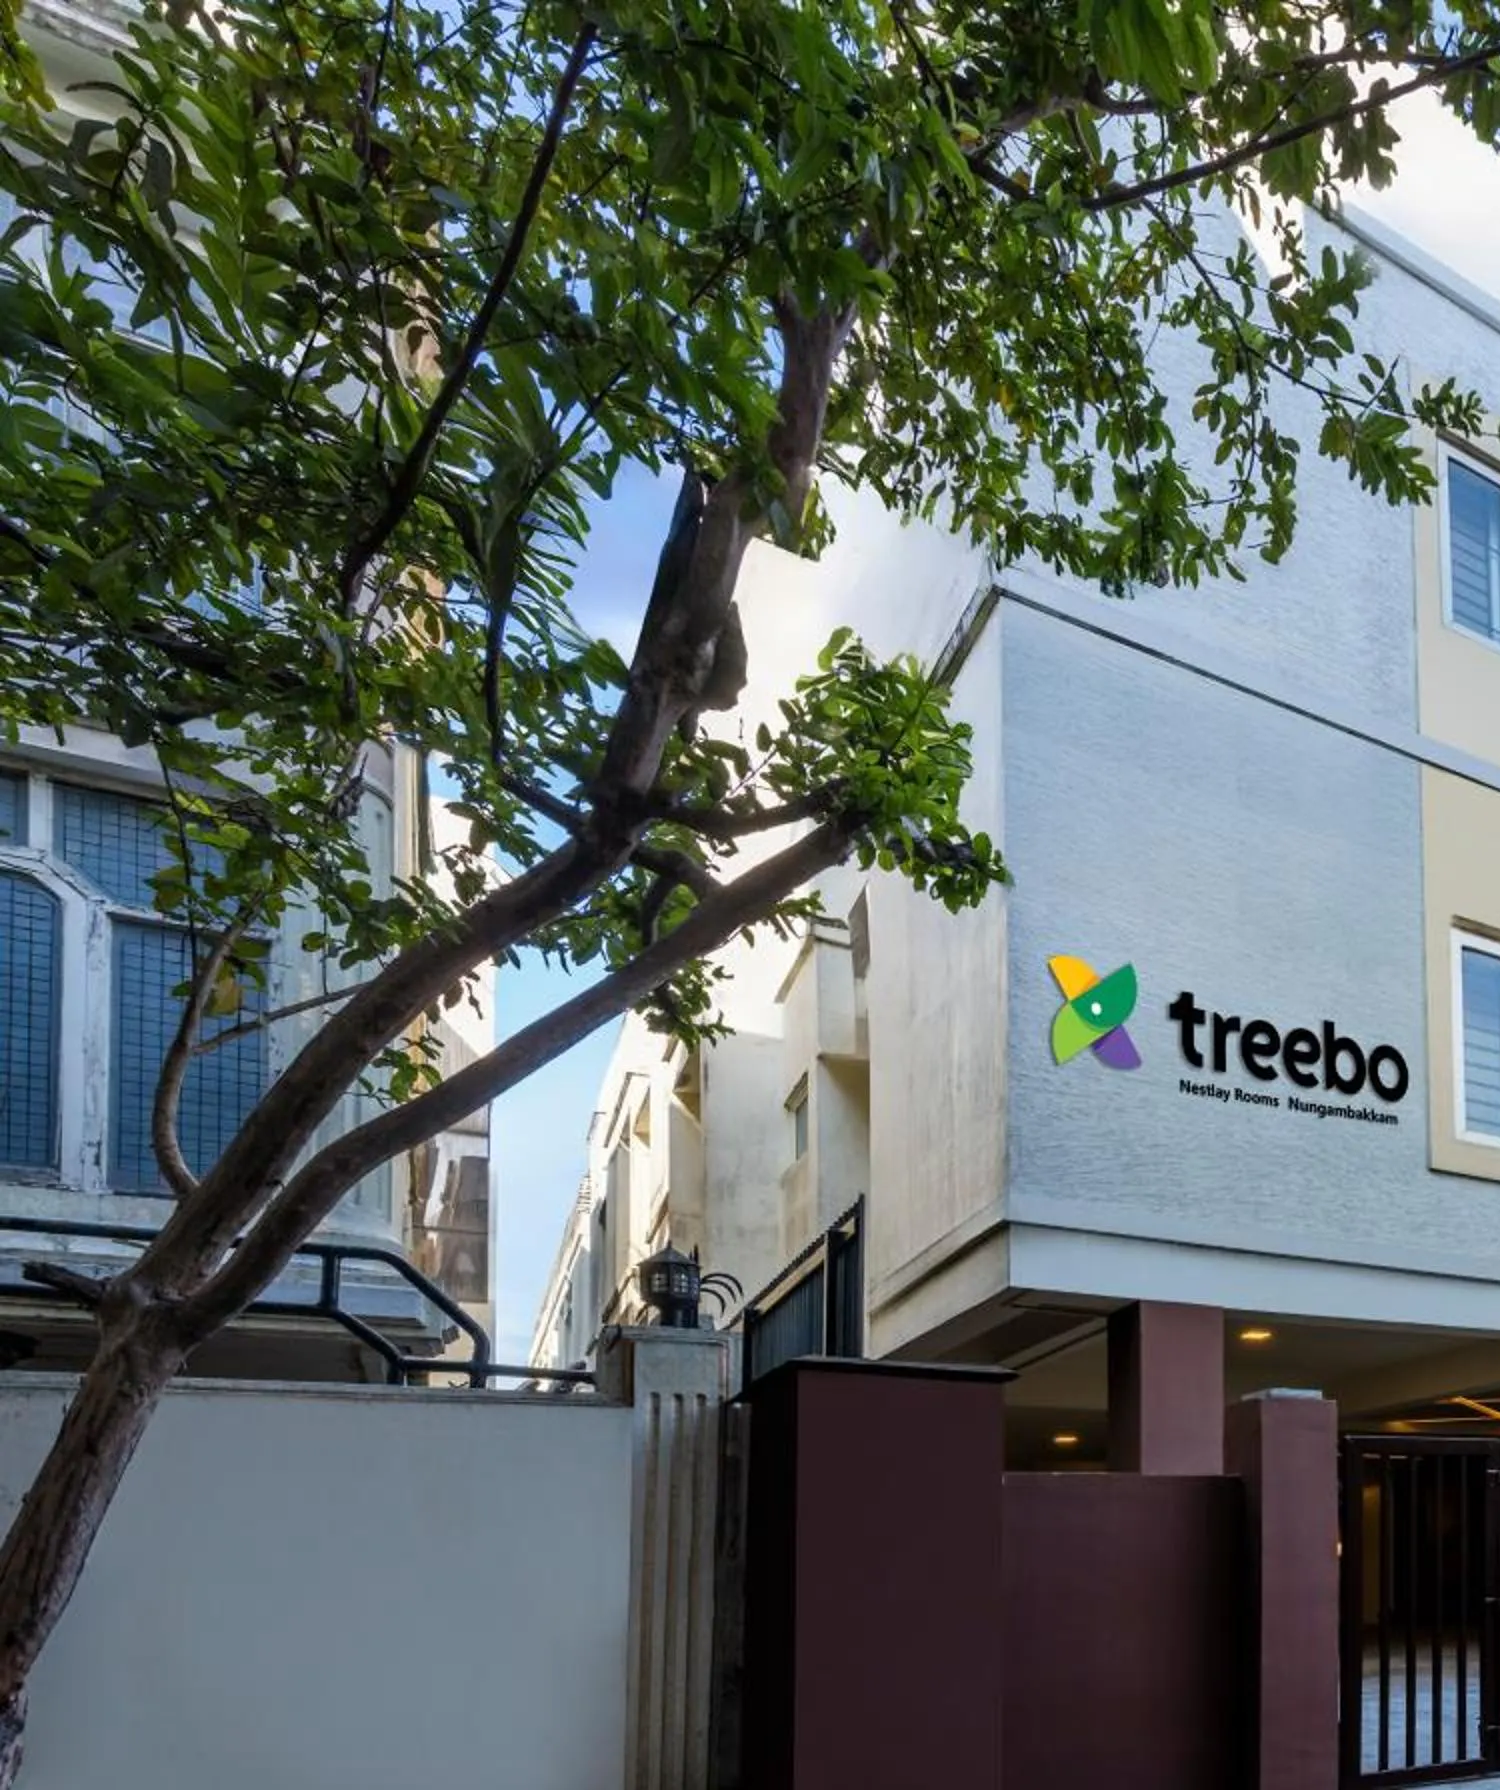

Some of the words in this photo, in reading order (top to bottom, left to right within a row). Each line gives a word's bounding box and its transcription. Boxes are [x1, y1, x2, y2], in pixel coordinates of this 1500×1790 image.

[1169, 991, 1409, 1102] treebo
[1178, 1079, 1230, 1102] Nestlay
[1234, 1087, 1280, 1109] Rooms
[1287, 1096, 1399, 1125] Nungambakkam
